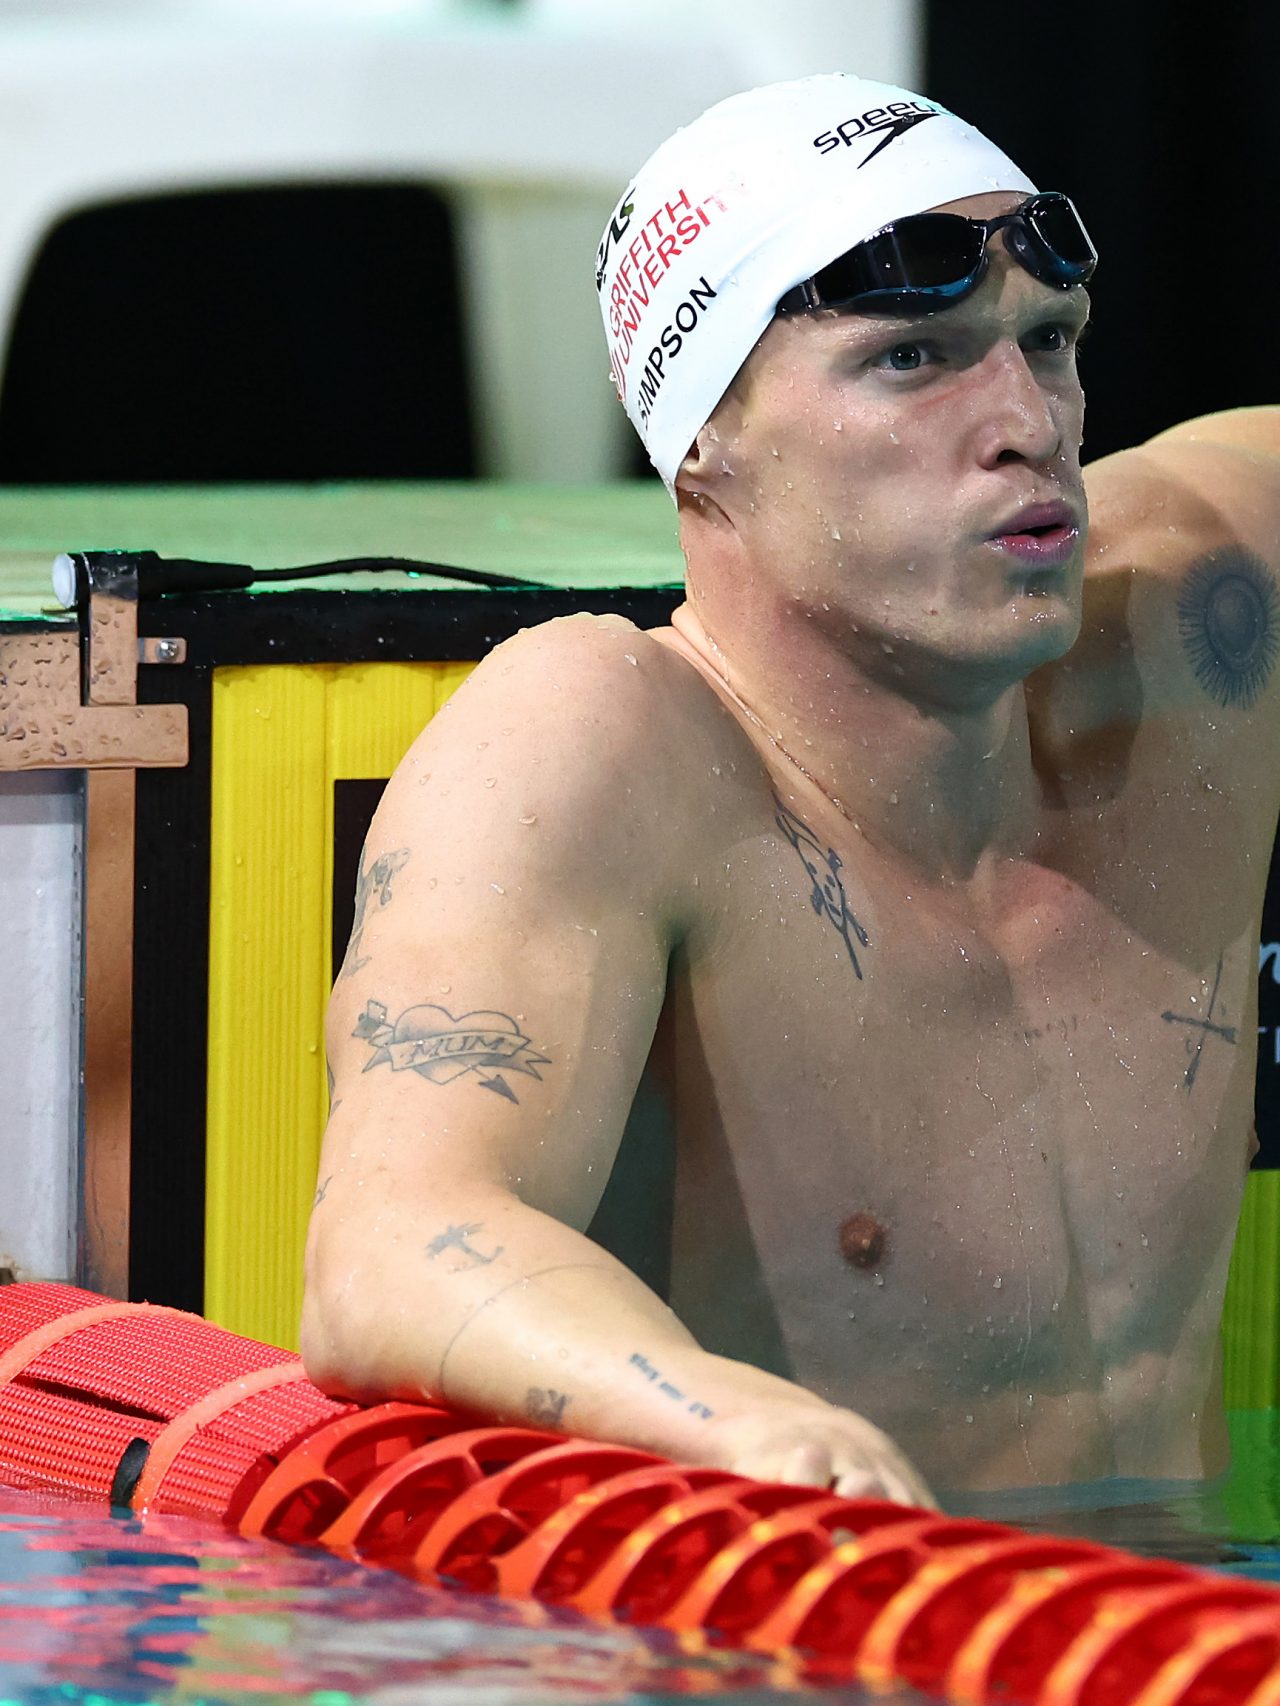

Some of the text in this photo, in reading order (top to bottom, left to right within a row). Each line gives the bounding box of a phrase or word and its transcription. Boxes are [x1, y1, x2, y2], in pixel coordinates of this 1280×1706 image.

[812, 101, 954, 155] speed
[609, 188, 692, 339] GRIFFITH
[619, 193, 730, 366] UNIVERSIT
[409, 1034, 507, 1064] MUM
